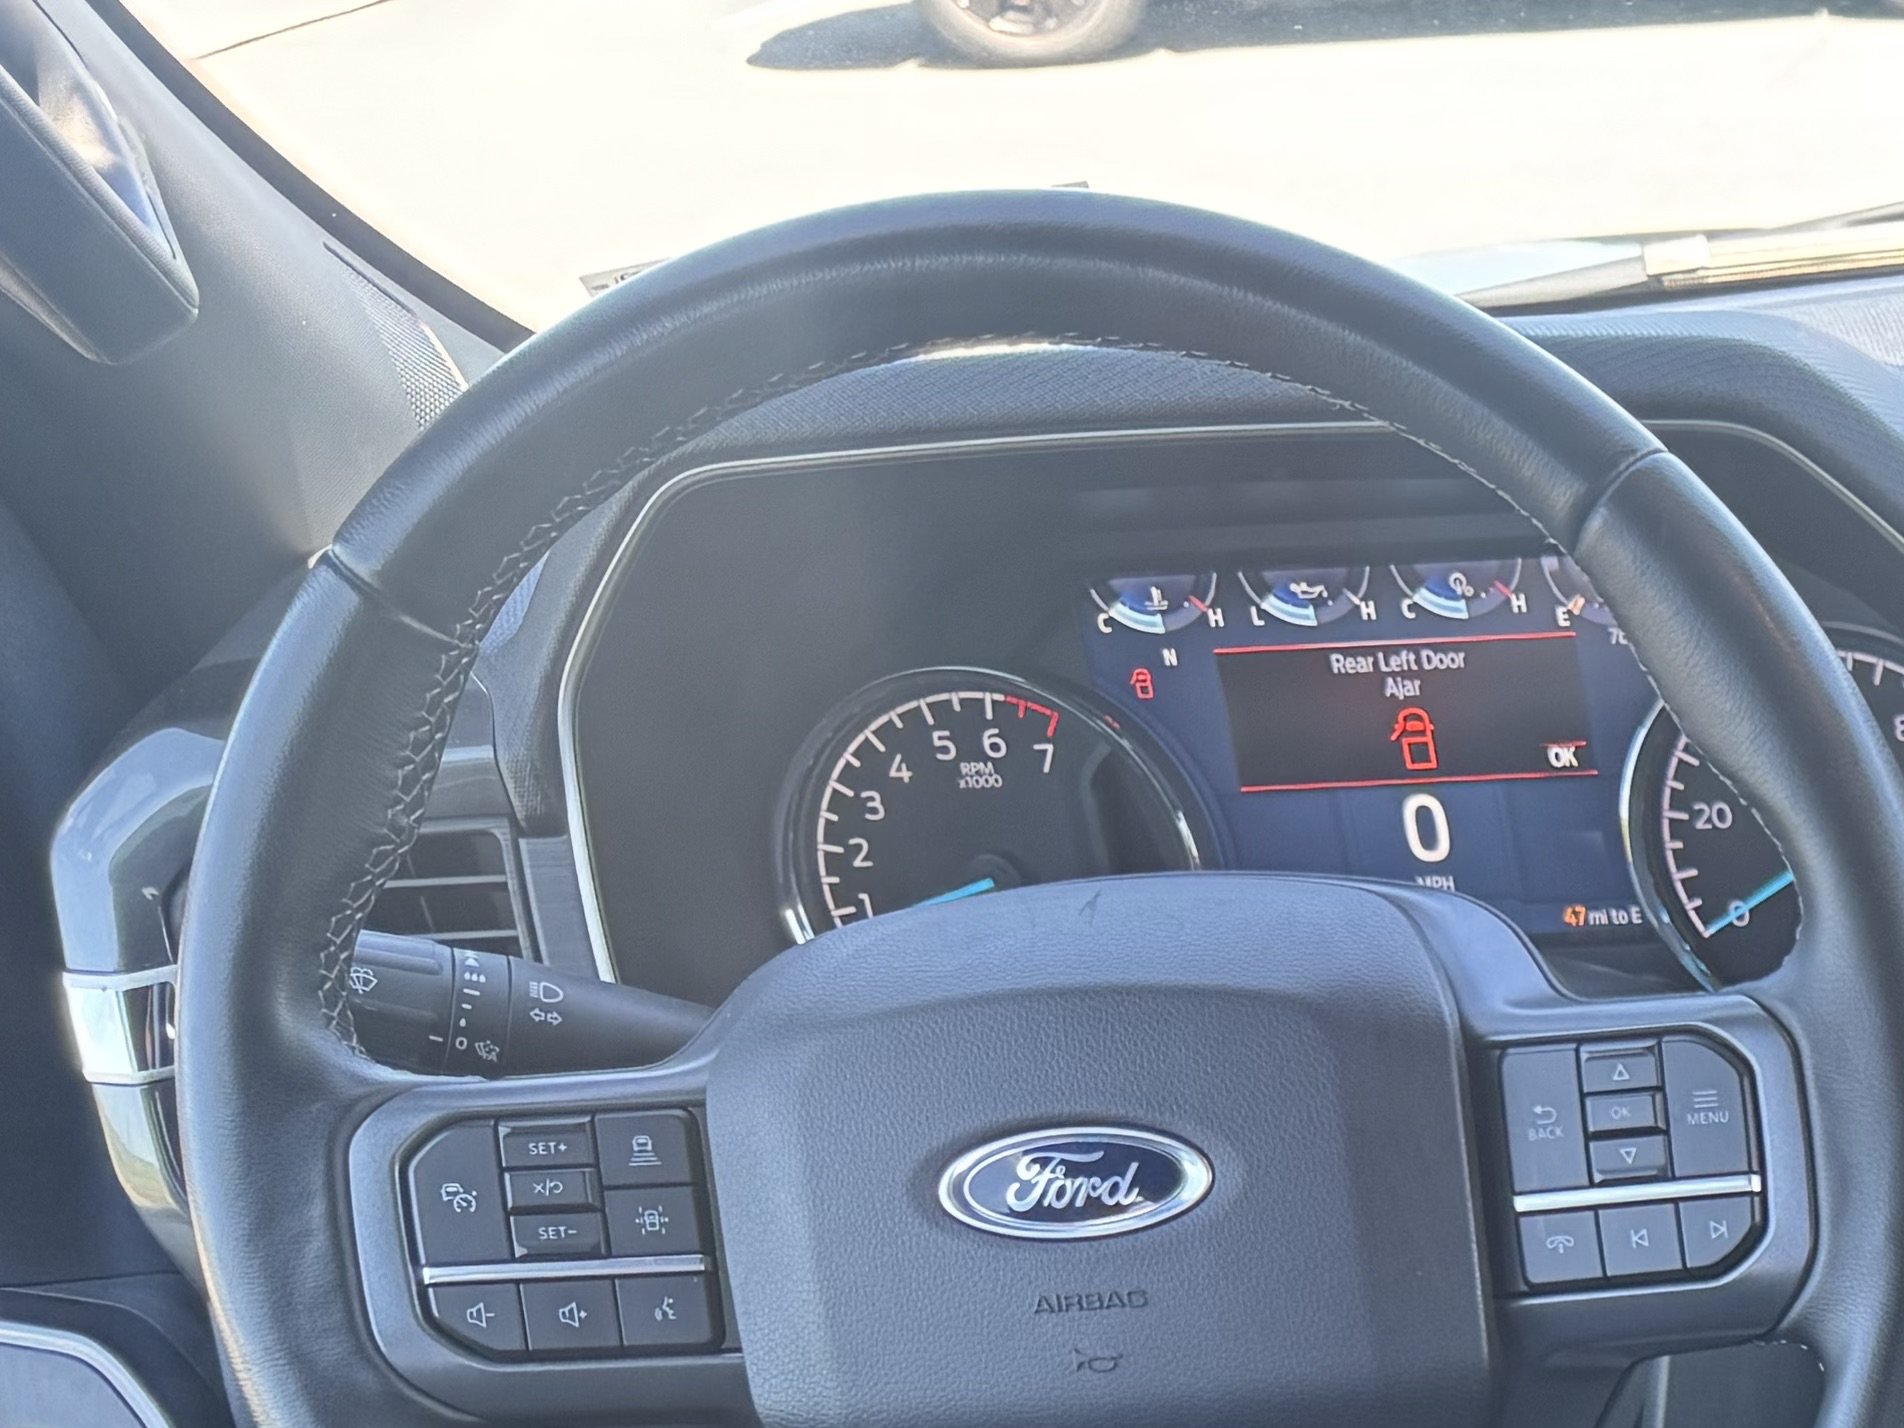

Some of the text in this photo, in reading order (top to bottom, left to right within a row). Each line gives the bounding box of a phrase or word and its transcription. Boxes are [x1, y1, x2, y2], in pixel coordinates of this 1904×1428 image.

[1361, 601, 1377, 621] H
[1401, 600, 1416, 619] C
[1511, 594, 1527, 613] H
[1098, 614, 1112, 634] C
[1208, 608, 1225, 628] H
[1251, 608, 1265, 627] L
[1556, 608, 1570, 627] E
[1162, 648, 1178, 667] N
[1330, 650, 1465, 674] Rear Left Door
[1384, 677, 1421, 699] Ajar
[933, 730, 957, 761] 5
[982, 728, 1007, 759] 6
[1033, 743, 1055, 774] 7
[1547, 747, 1577, 768] OK
[888, 755, 912, 784] 4
[960, 761, 995, 777] RPM
[861, 790, 885, 821] 3
[1693, 802, 1733, 831] 20
[1403, 793, 1450, 864] 0
[849, 837, 874, 868] 2
[1563, 905, 1587, 926] 47
[1612, 908, 1629, 925] to
[1611, 1105, 1631, 1119] OK
[1687, 1109, 1729, 1126] MENU
[1528, 1127, 1564, 1141] BACK
[1006, 1150, 1140, 1212] Ford
[1033, 1288, 1149, 1315] AIRBAG
